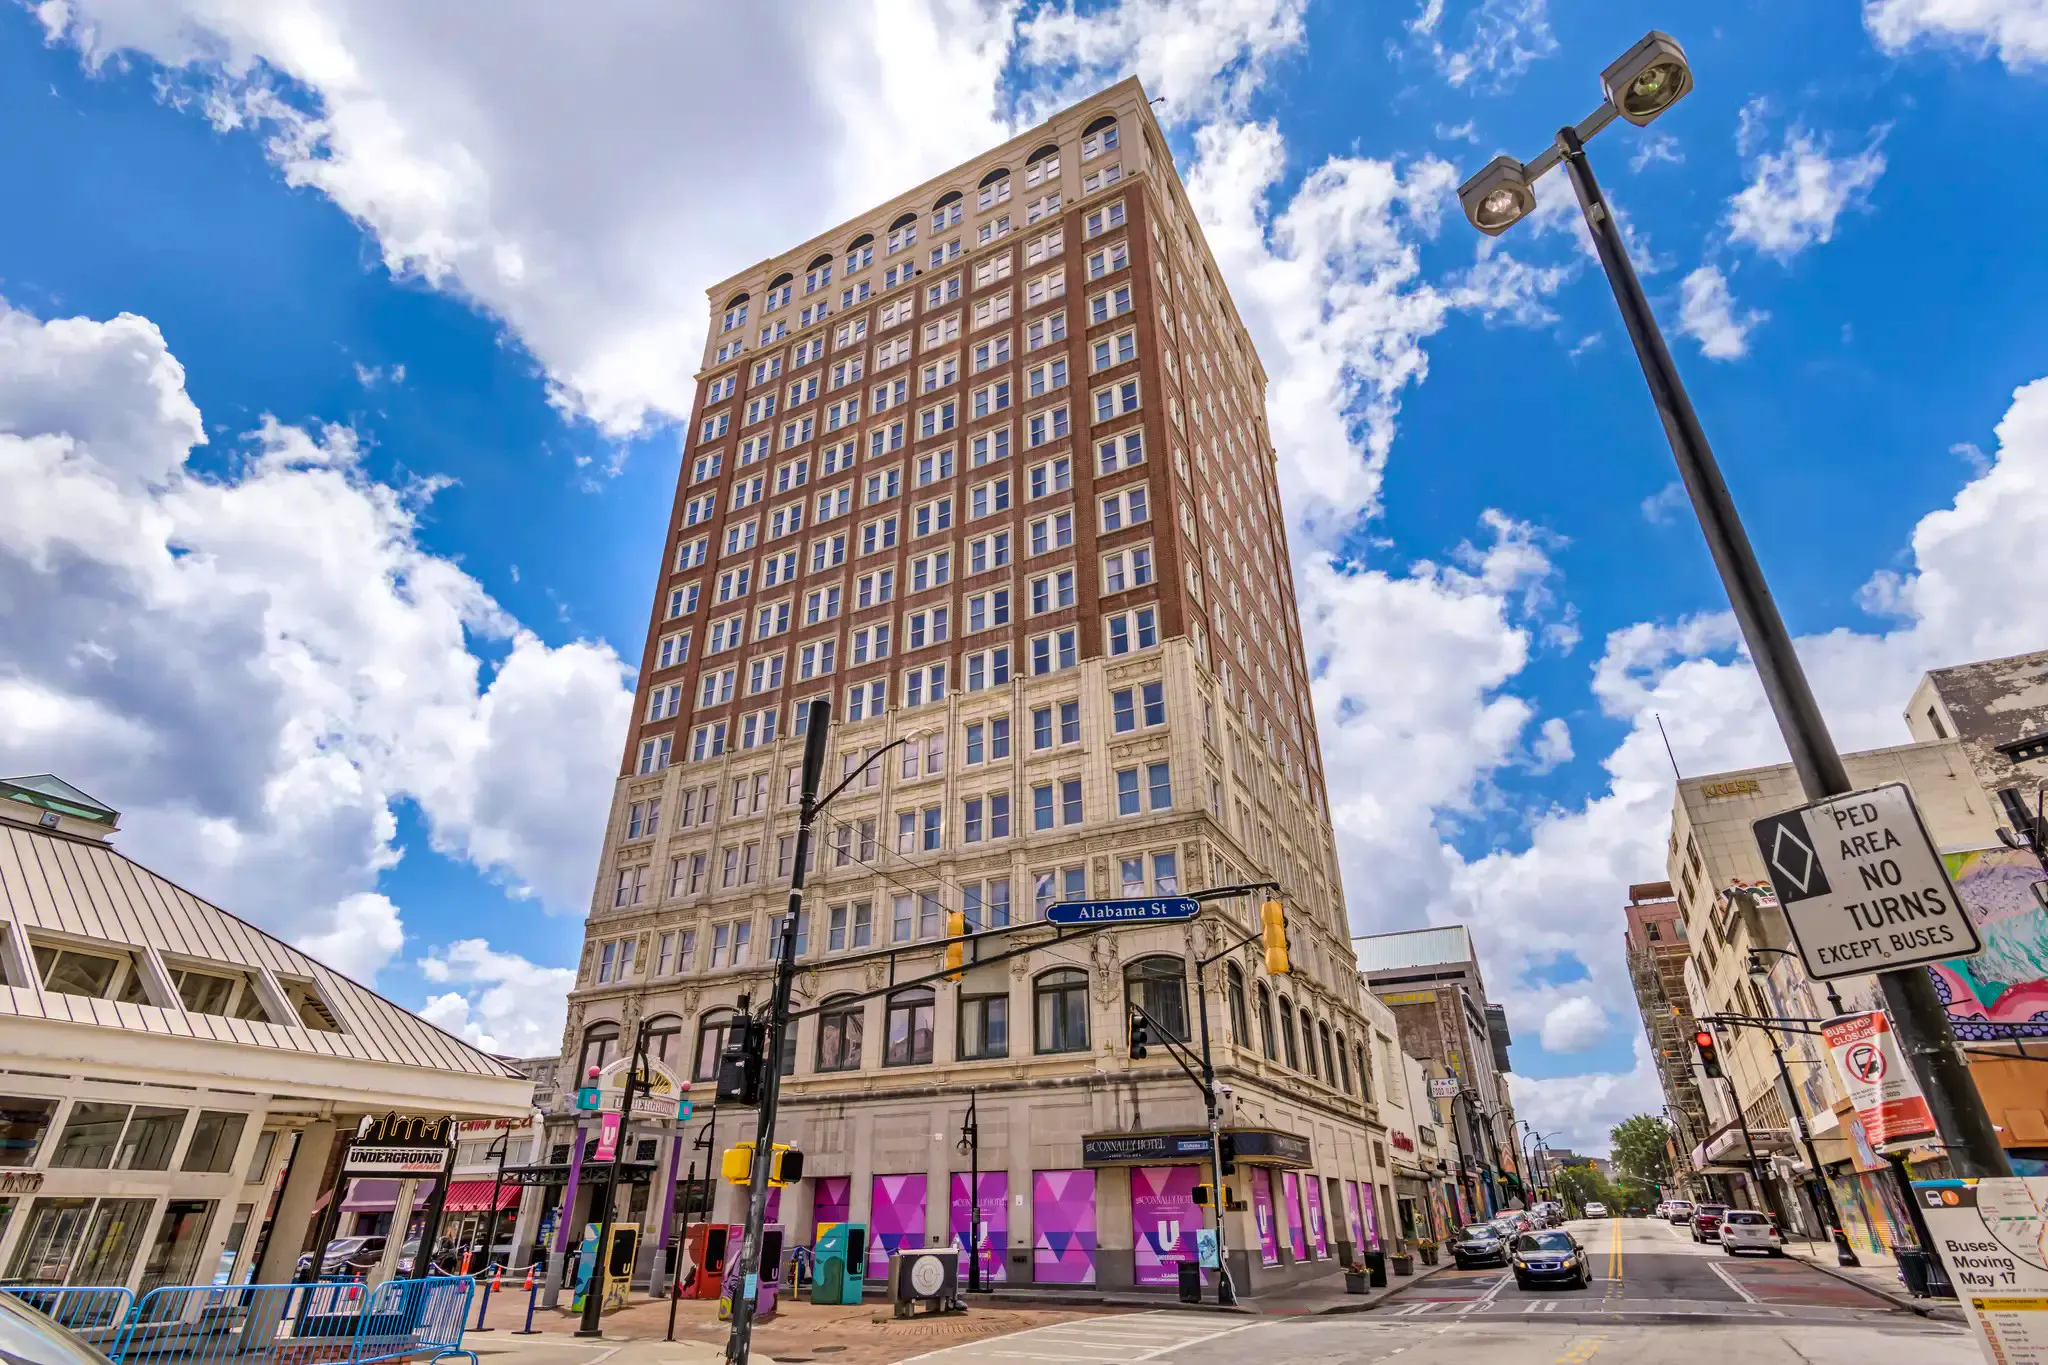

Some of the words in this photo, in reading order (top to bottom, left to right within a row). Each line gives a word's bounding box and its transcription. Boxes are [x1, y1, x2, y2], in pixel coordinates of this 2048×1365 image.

[1704, 778, 1759, 797] KRESS
[1833, 803, 1878, 830] PED
[1840, 828, 1901, 860] AREA
[1858, 859, 1901, 891] NO
[1078, 905, 1146, 919] Alabama
[1151, 903, 1167, 915] St
[1180, 903, 1195, 911] SW
[1844, 887, 1947, 931] TURNS
[1817, 938, 1882, 965] EXCEPT
[1889, 924, 1954, 951] BUSES
[1826, 1026, 1846, 1038] BUS
[1846, 1017, 1871, 1031] STOP
[1832, 1027, 1877, 1046] CLOSURE
[603, 1127, 616, 1145] U
[1092, 1140, 1136, 1152] CONNALLY
[1137, 1138, 1165, 1150] HOTEL
[350, 1151, 443, 1164] UNDERGROUND
[1158, 1220, 1180, 1251] U
[1946, 1240, 1998, 1252] Buses
[1952, 1256, 2015, 1270] Moving
[1959, 1272, 1994, 1287] May
[2000, 1272, 2016, 1284] 17
